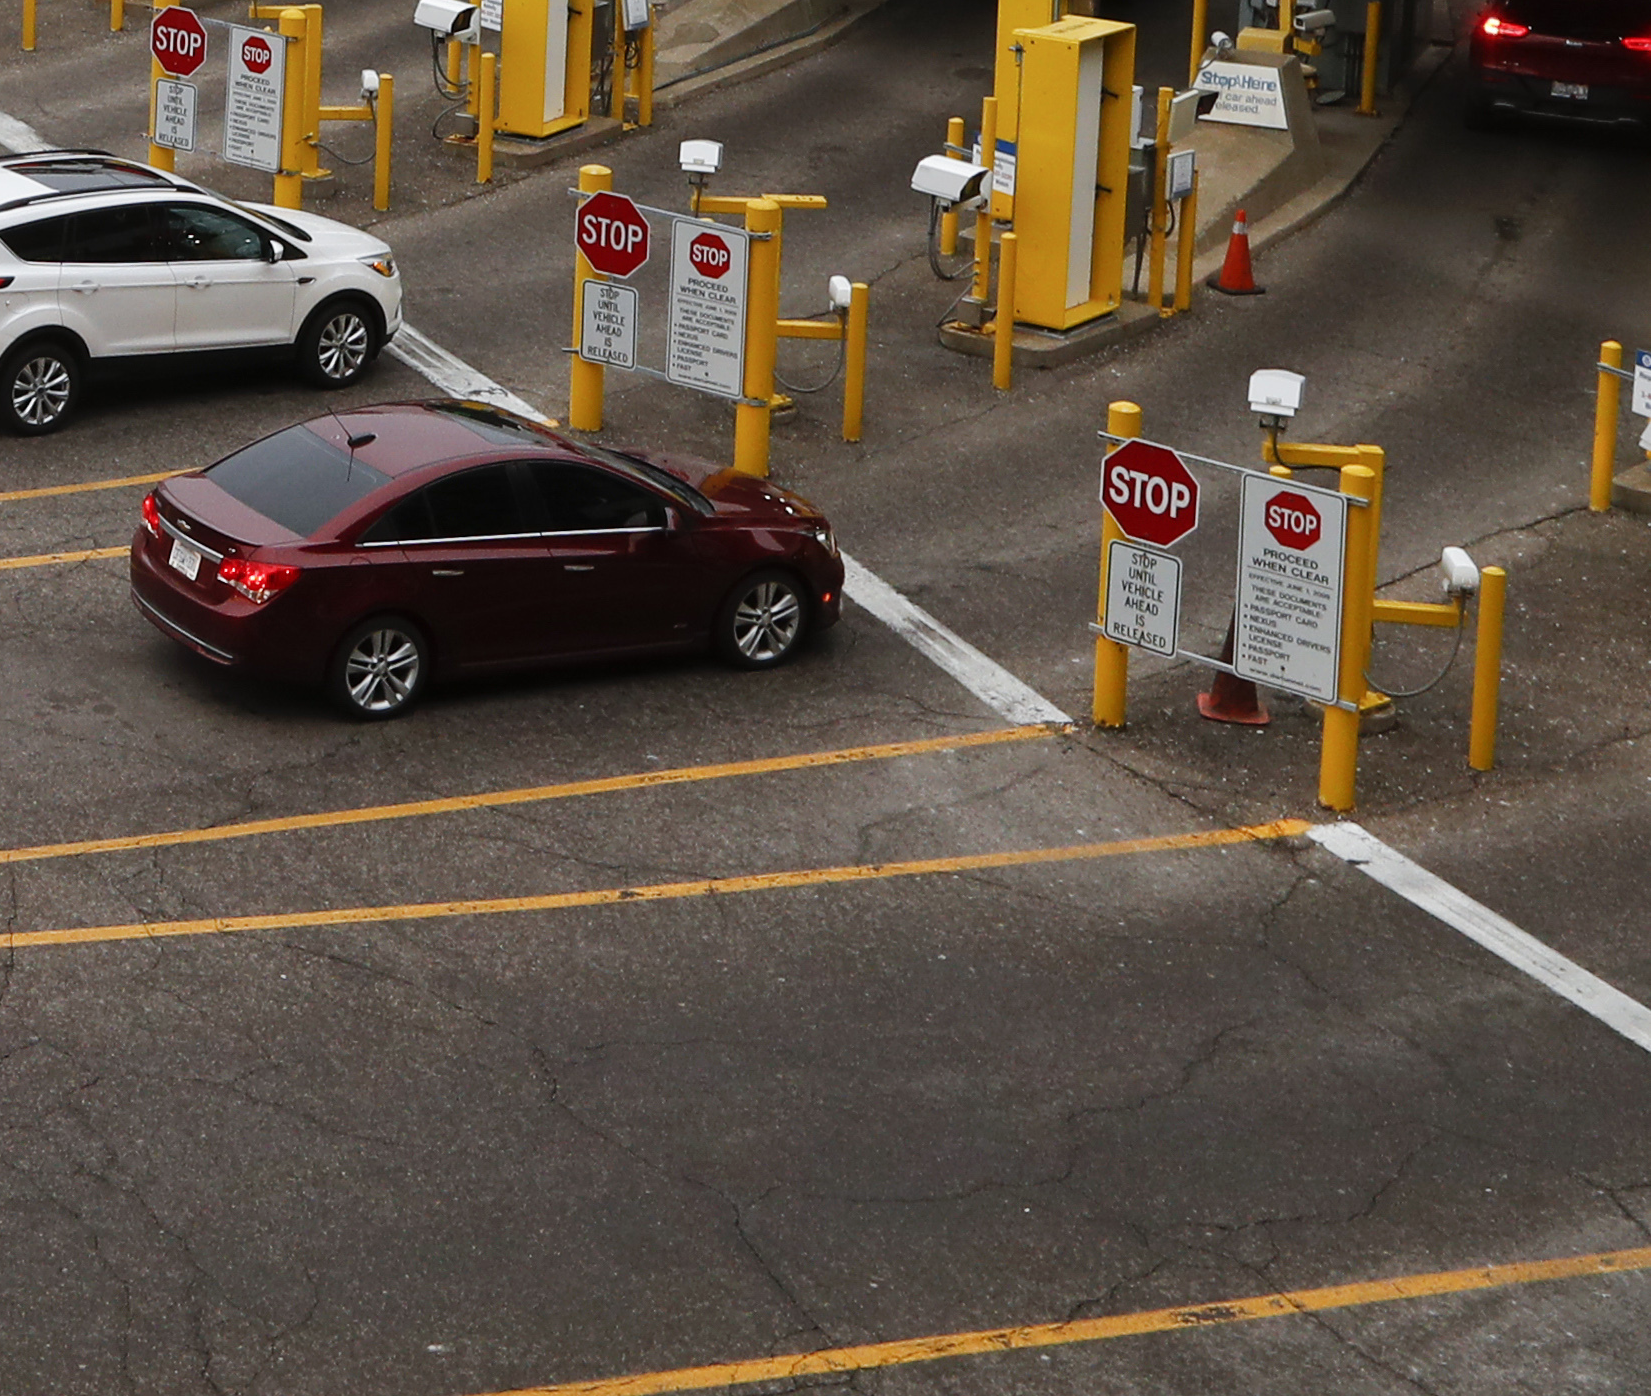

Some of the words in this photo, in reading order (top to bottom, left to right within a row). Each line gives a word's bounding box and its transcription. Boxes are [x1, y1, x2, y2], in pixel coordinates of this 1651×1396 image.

[156, 25, 202, 57] STOP
[243, 46, 270, 64] STOP
[235, 80, 253, 91] WHEN
[255, 84, 277, 95] CLEAR
[240, 74, 271, 86] PROCEED
[1201, 70, 1237, 90] Stop
[1241, 75, 1277, 92] Here
[169, 85, 184, 95] STOP
[167, 96, 183, 106] UNTIL
[1225, 92, 1242, 102] car
[1245, 94, 1277, 106] ahead
[163, 105, 187, 116] VEHICLE
[1215, 102, 1260, 114] eleased.
[165, 114, 185, 126] AHEAD
[171, 126, 177, 135] IS
[158, 134, 189, 148] RELEASED
[582, 214, 643, 254] STOP
[692, 244, 728, 266] STOP
[688, 278, 729, 293] PROCEED
[599, 288, 620, 300] STOP
[679, 285, 705, 298] WHEN
[708, 292, 736, 304] CLEAR
[597, 300, 620, 313] UNTIL
[593, 311, 625, 326] VEHICLE
[595, 323, 623, 337] AHEAD
[678, 324, 709, 334] PASSPORT
[711, 330, 729, 340] CARD
[678, 332, 699, 340] NEXUS
[604, 336, 612, 348] IS
[678, 340, 711, 352] ENHANCED
[587, 346, 629, 364] RELEASED
[677, 347, 703, 357] LICENSE
[677, 354, 709, 366] PASSPORT
[677, 363, 691, 371] FAST
[1109, 466, 1191, 518] STOP
[1269, 505, 1317, 536] STOP
[1131, 554, 1157, 570] STOP
[1263, 548, 1319, 570] PROCEED
[1128, 567, 1157, 586] UNTIL
[1252, 556, 1287, 574] WHEN
[1291, 567, 1329, 585] CLEAR
[1249, 572, 1283, 586] EFFECTIVE
[1287, 583, 1303, 592] JUNE
[1121, 580, 1165, 603] VEHICLE
[1251, 584, 1275, 596] THESE
[1279, 592, 1327, 611] DOCUMENTS
[1255, 594, 1269, 604] ARE
[1124, 596, 1159, 616] AHEAD
[1135, 614, 1145, 627] IS
[1249, 614, 1277, 628] NEXUS
[1250, 604, 1292, 621] PASSPORT
[1295, 616, 1319, 629] CARD
[1113, 622, 1167, 648] RELEASED
[1249, 624, 1294, 643] ENHANCED
[1297, 637, 1331, 654] DRIVERS
[1249, 634, 1282, 648] LICENSE
[1247, 654, 1268, 666] FAST
[1248, 644, 1291, 662] PASSPORT
